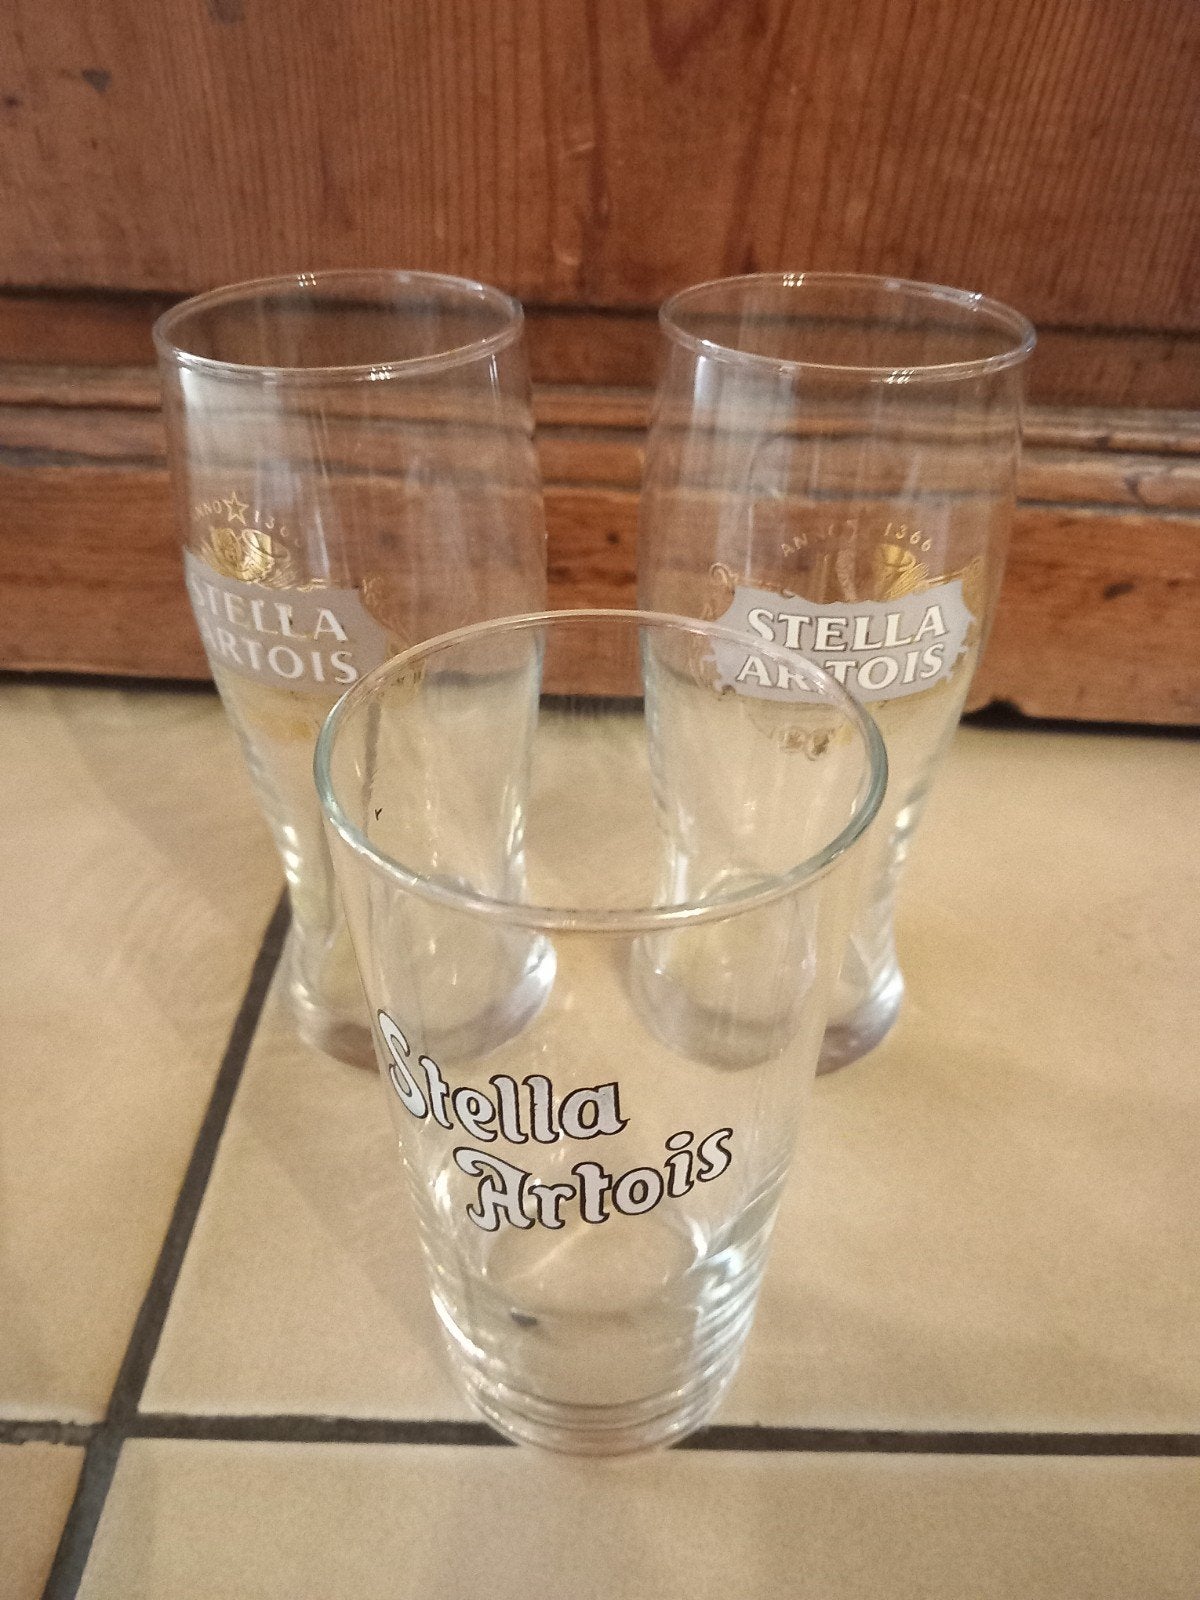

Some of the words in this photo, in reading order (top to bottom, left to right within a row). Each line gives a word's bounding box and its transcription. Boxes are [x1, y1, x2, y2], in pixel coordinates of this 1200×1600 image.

[884, 522, 932, 552] 1366
[747, 604, 948, 651] STELLA
[735, 642, 944, 695] ARTOIS
[377, 1008, 631, 1144] Stella
[453, 1127, 733, 1232] Artois
